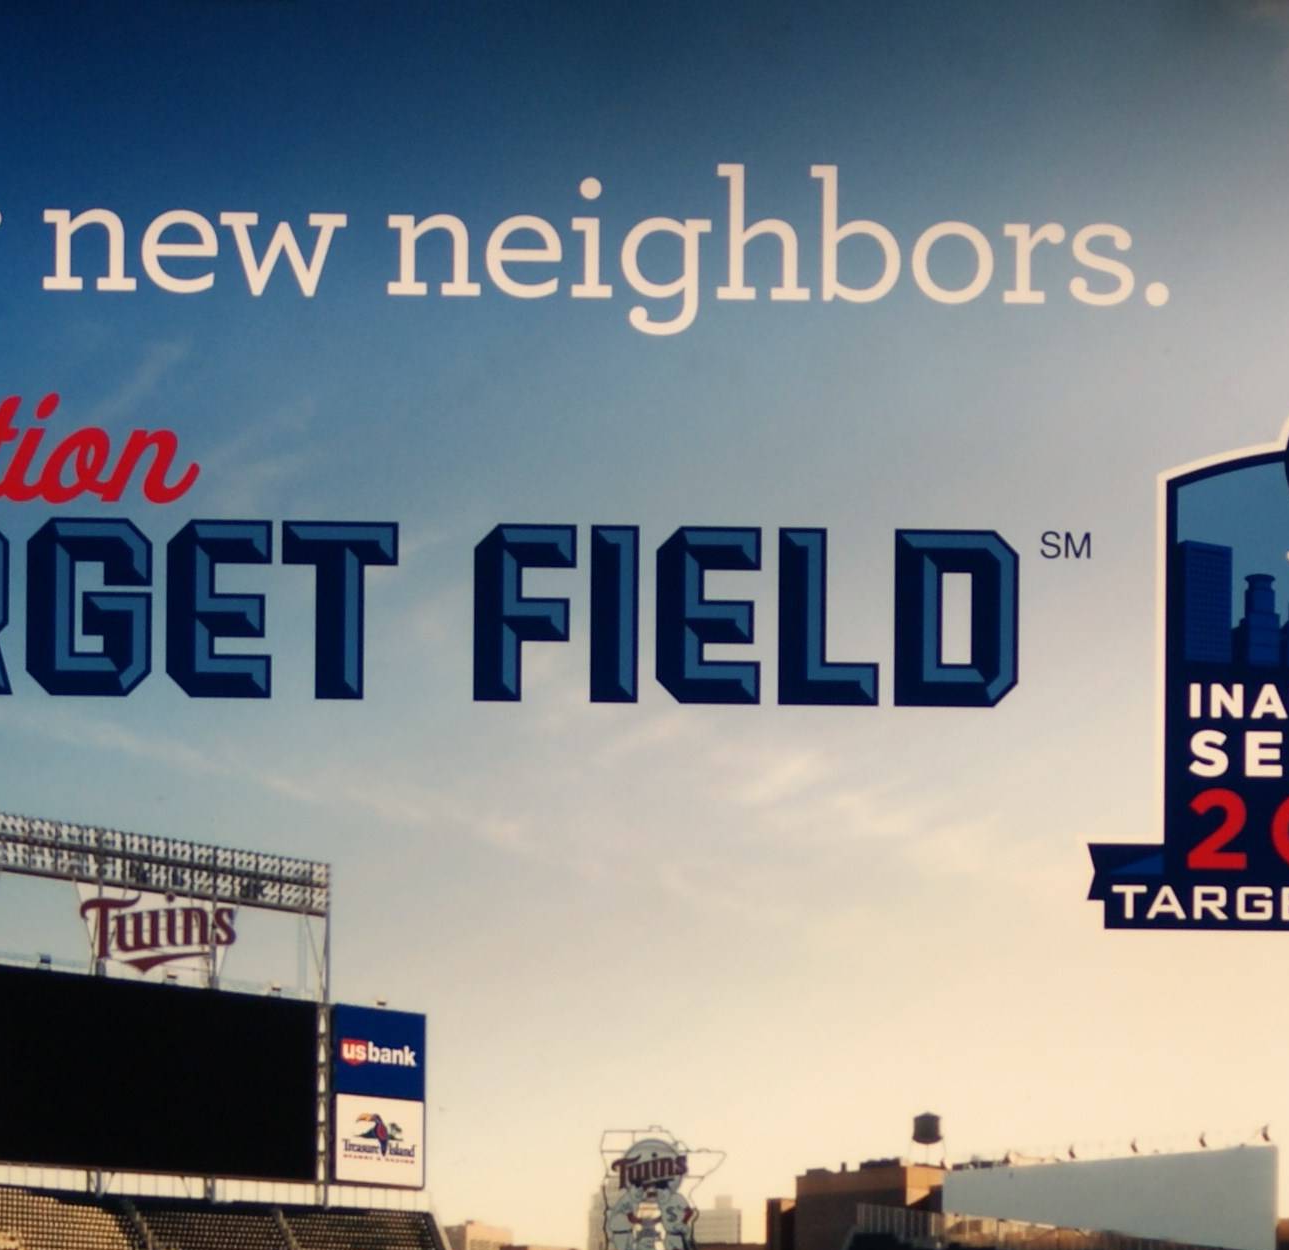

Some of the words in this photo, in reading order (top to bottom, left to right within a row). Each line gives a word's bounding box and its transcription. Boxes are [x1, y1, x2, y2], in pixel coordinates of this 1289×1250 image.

[42, 207, 348, 298] new
[386, 163, 1170, 336] neighbors.
[472, 522, 1020, 709] FIELD
[1039, 531, 1093, 560] SM
[78, 891, 237, 960] Twins
[611, 1151, 689, 1190] Twins
